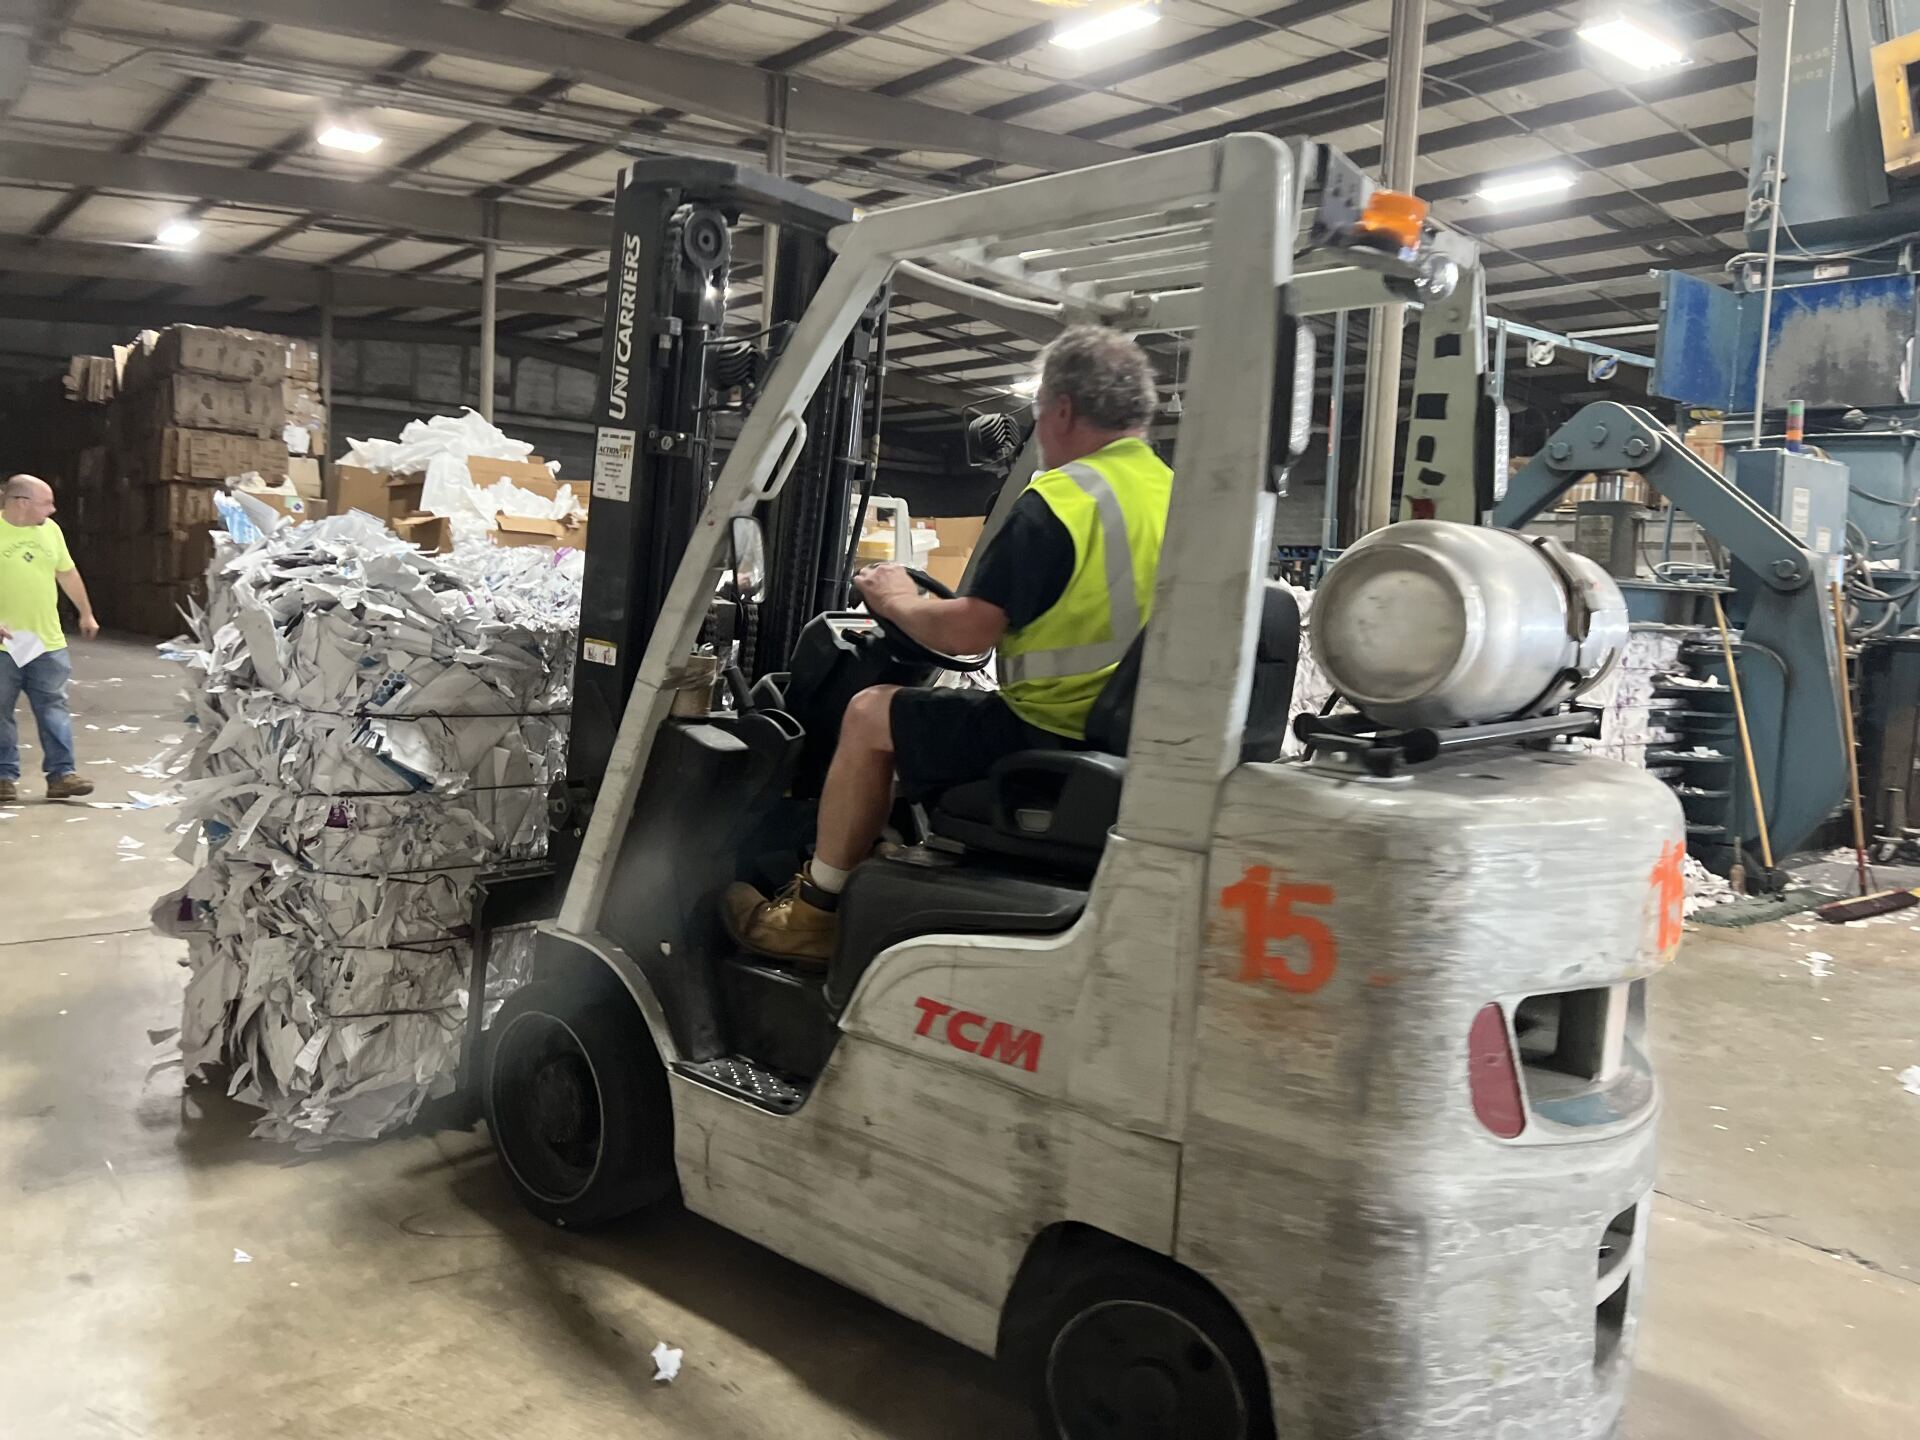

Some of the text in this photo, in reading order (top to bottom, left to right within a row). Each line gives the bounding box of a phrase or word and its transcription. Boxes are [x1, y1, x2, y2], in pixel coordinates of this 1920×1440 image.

[599, 446, 620, 455] ACTION
[1221, 865, 1337, 993] 15
[914, 996, 1043, 1073] TCM
